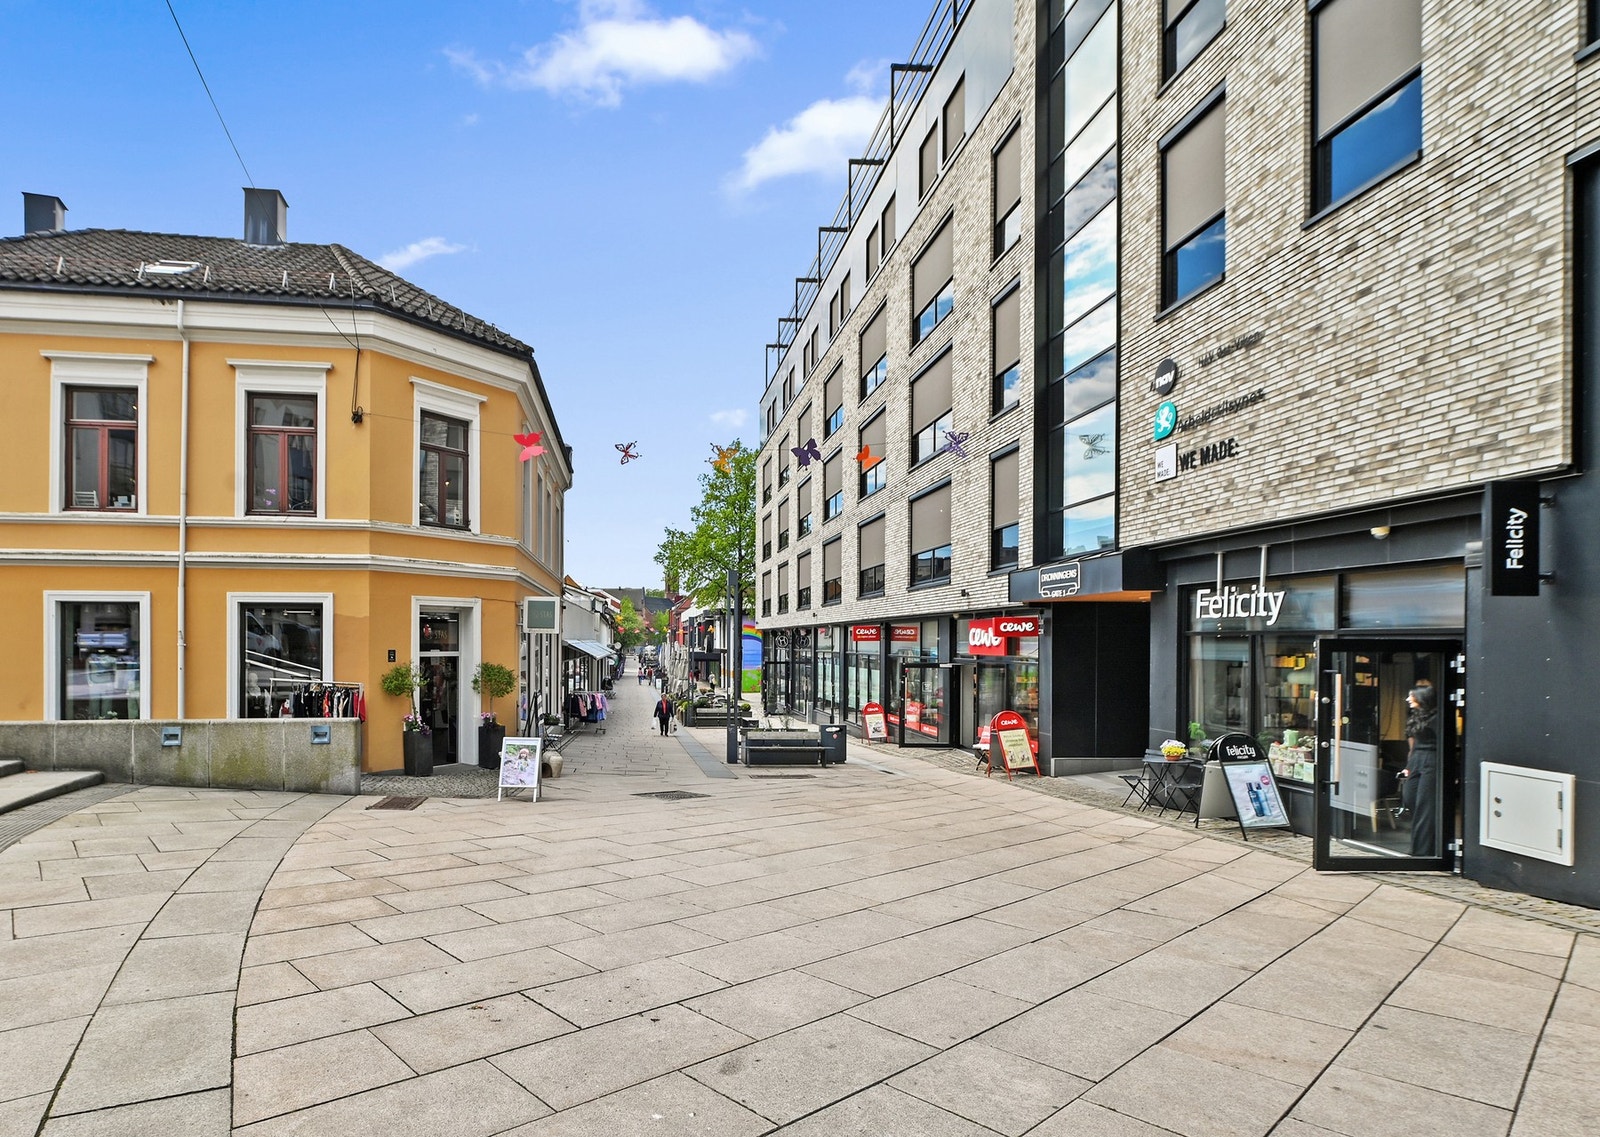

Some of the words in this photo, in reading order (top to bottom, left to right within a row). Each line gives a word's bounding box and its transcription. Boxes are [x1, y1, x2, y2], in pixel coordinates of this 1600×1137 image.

[1156, 370, 1175, 388] nav
[1179, 450, 1198, 472] WE
[1200, 438, 1240, 466] MADE:
[1505, 507, 1528, 569] Felicity
[1041, 569, 1077, 582] DRONNINGENS
[1196, 584, 1286, 626] Felicity
[1000, 621, 1034, 632] cewe
[1226, 744, 1256, 757] Felicity
